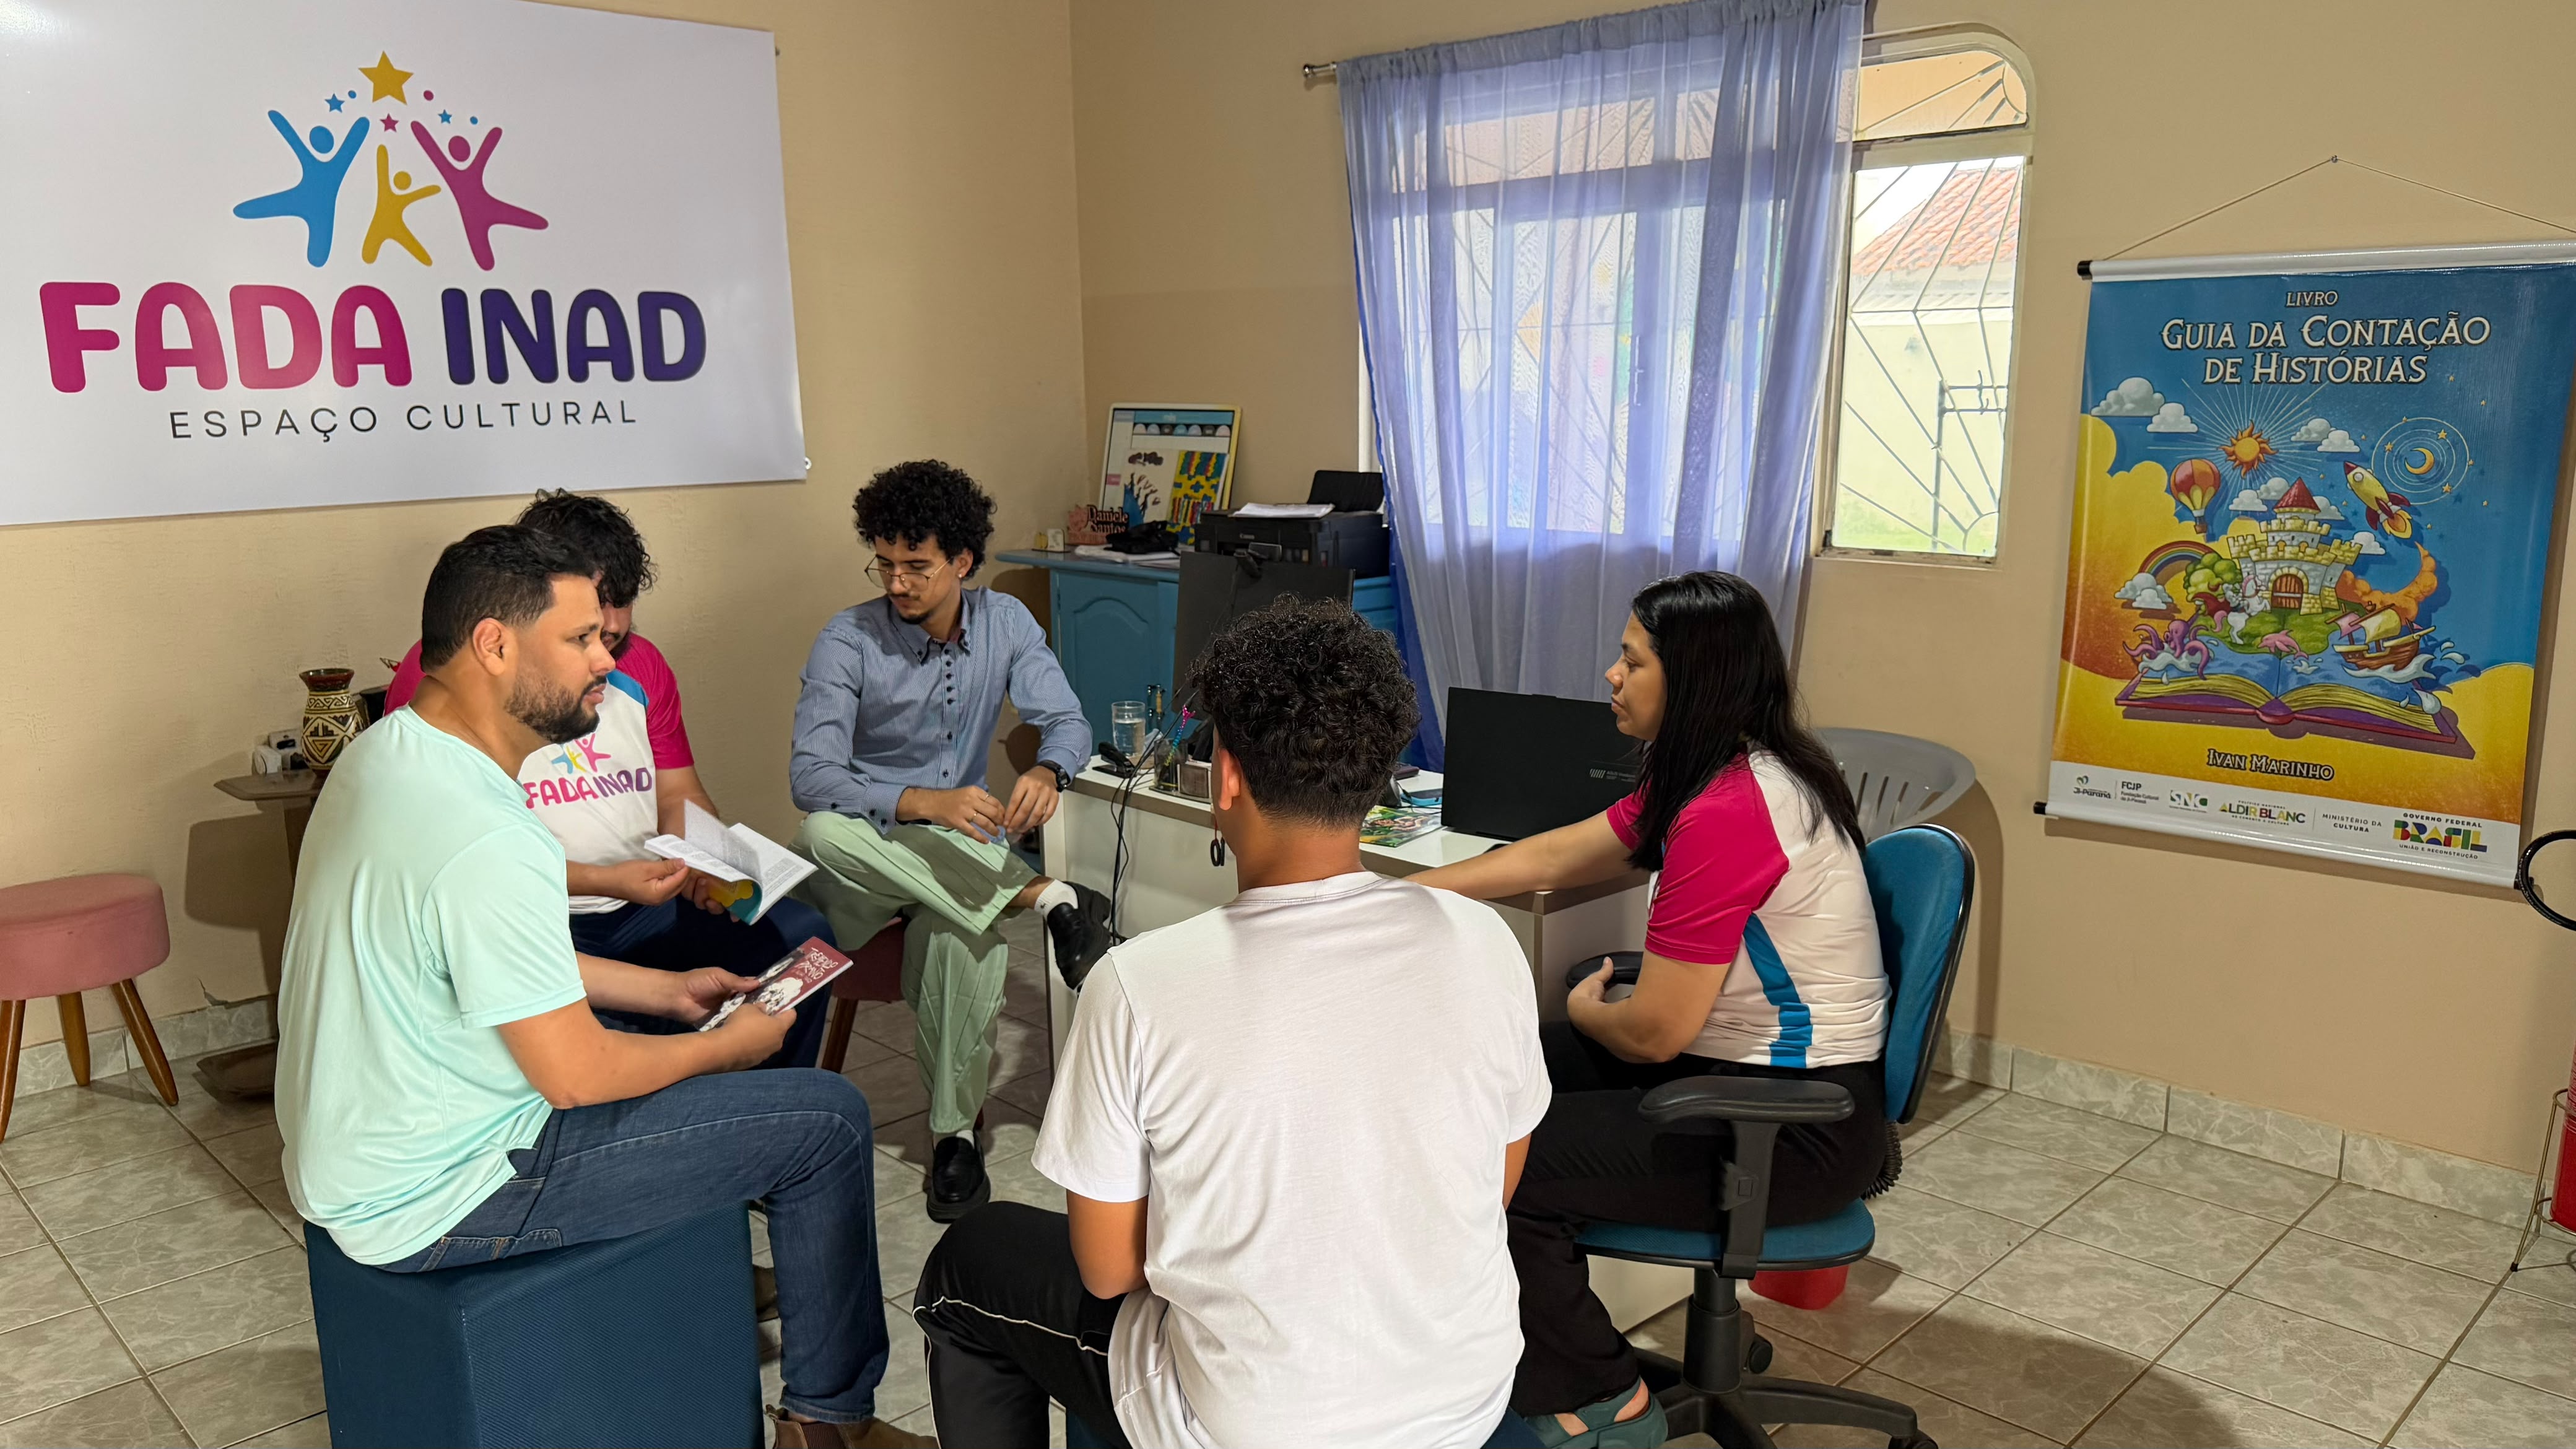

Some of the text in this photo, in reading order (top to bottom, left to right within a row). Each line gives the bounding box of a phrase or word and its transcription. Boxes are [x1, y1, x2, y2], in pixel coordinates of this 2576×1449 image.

[2286, 290, 2339, 307] LIVRO
[40, 281, 707, 393] FADA INAD
[2160, 311, 2491, 351] GUIA DA CONTAÇÃO
[2203, 349, 2428, 384] DE HISTÓRIAS
[170, 399, 637, 443] ESPAÇO CULTURAL
[1087, 504, 1129, 524] Daniele
[2206, 748, 2335, 781] IVAN MARINHO
[523, 767, 653, 809] FADA INAD
[2121, 781, 2142, 791] FCJP
[2219, 803, 2258, 817] ALDIR
[2258, 807, 2306, 824] BLANC
[2403, 812, 2482, 828] GOVERNO FEDERAL
[2333, 822, 2370, 833] CULTURA
[2392, 819, 2488, 853] BRASIL
[2399, 843, 2419, 851] UNIÃO
[2427, 847, 2479, 859] RECONSTRUÇÃO
